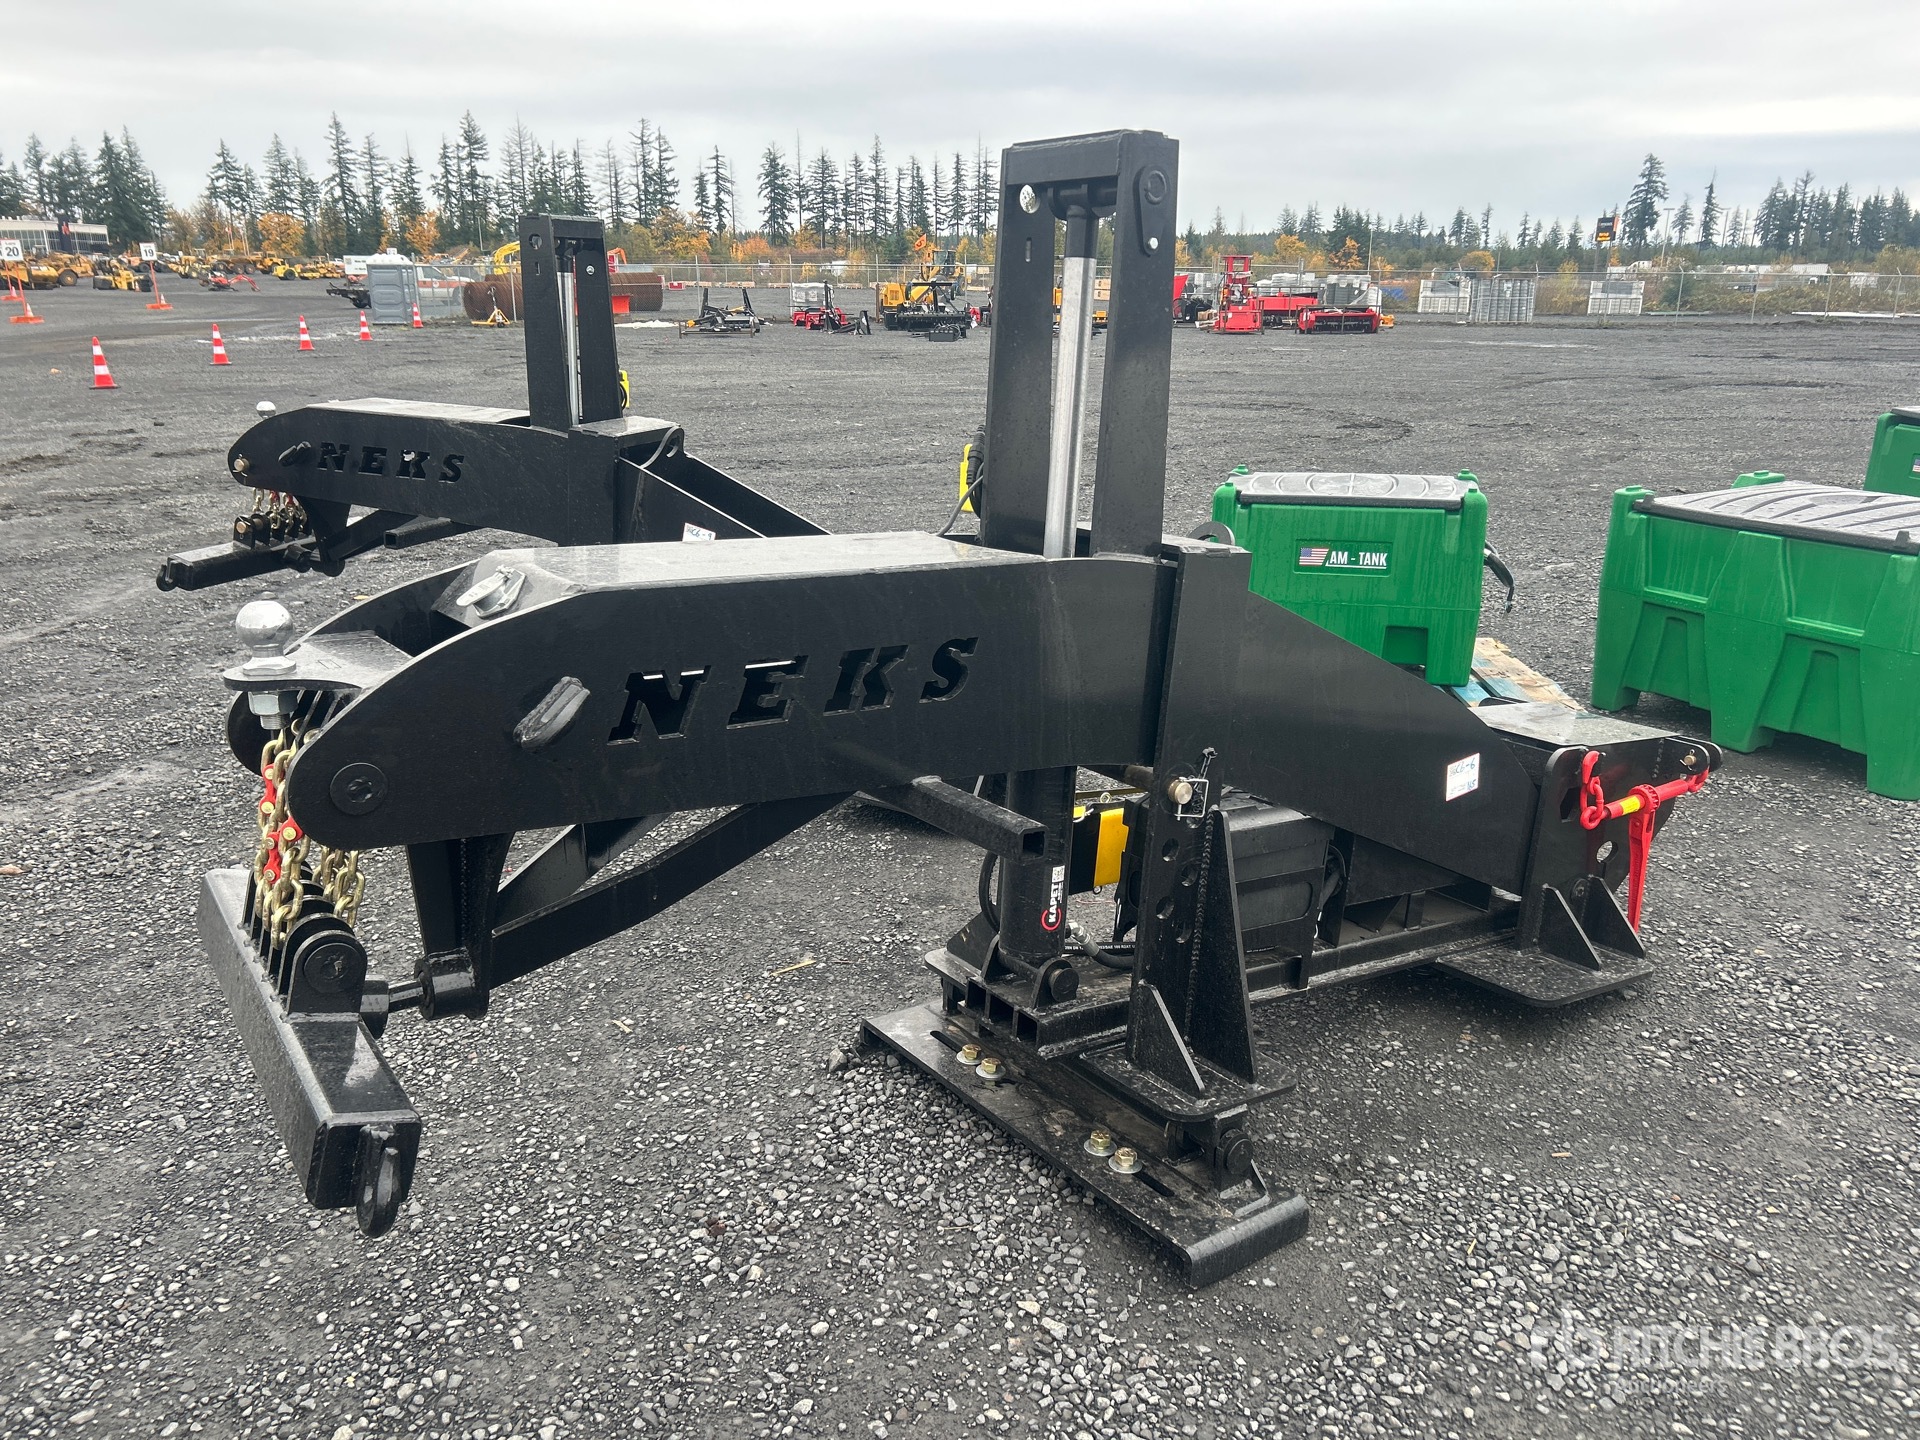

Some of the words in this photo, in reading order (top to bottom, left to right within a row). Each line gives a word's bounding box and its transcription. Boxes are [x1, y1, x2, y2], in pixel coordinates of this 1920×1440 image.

[4, 246, 20, 257] 20
[143, 248, 154, 257] 19
[316, 441, 465, 484] NEKS
[1329, 550, 1348, 565] AM
[1358, 551, 1388, 567] TANK
[606, 636, 979, 746] NEKS
